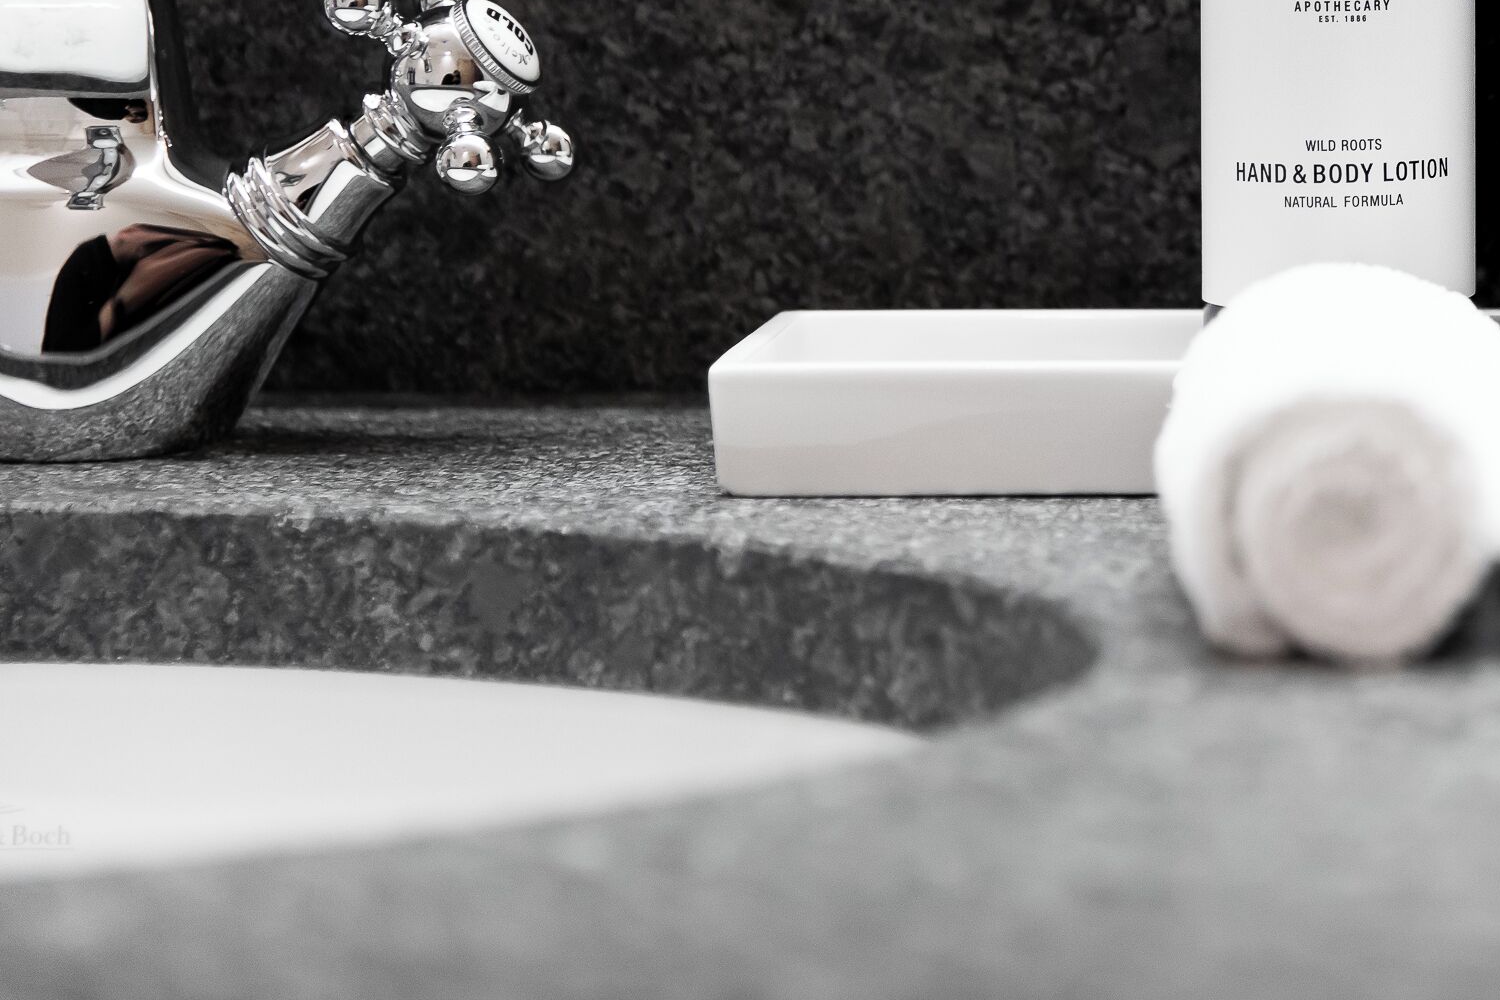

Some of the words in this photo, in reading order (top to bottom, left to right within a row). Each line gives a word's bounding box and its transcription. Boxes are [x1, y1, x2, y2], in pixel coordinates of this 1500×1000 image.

[1294, 0, 1390, 13] APOTHECARY
[1318, 14, 1339, 23] EST.
[1344, 14, 1367, 23] 1886
[486, 7, 534, 56] COLD
[1305, 138, 1336, 152] WILD
[1341, 138, 1382, 152] ROOTS
[1236, 161, 1287, 184] HAND
[1292, 163, 1308, 184] &
[1313, 162, 1374, 184] BODY
[1383, 156, 1448, 182] LOTION
[1284, 195, 1338, 209] NATURAL
[1344, 193, 1404, 208] FORMULA
[11, 824, 71, 846] Boch
